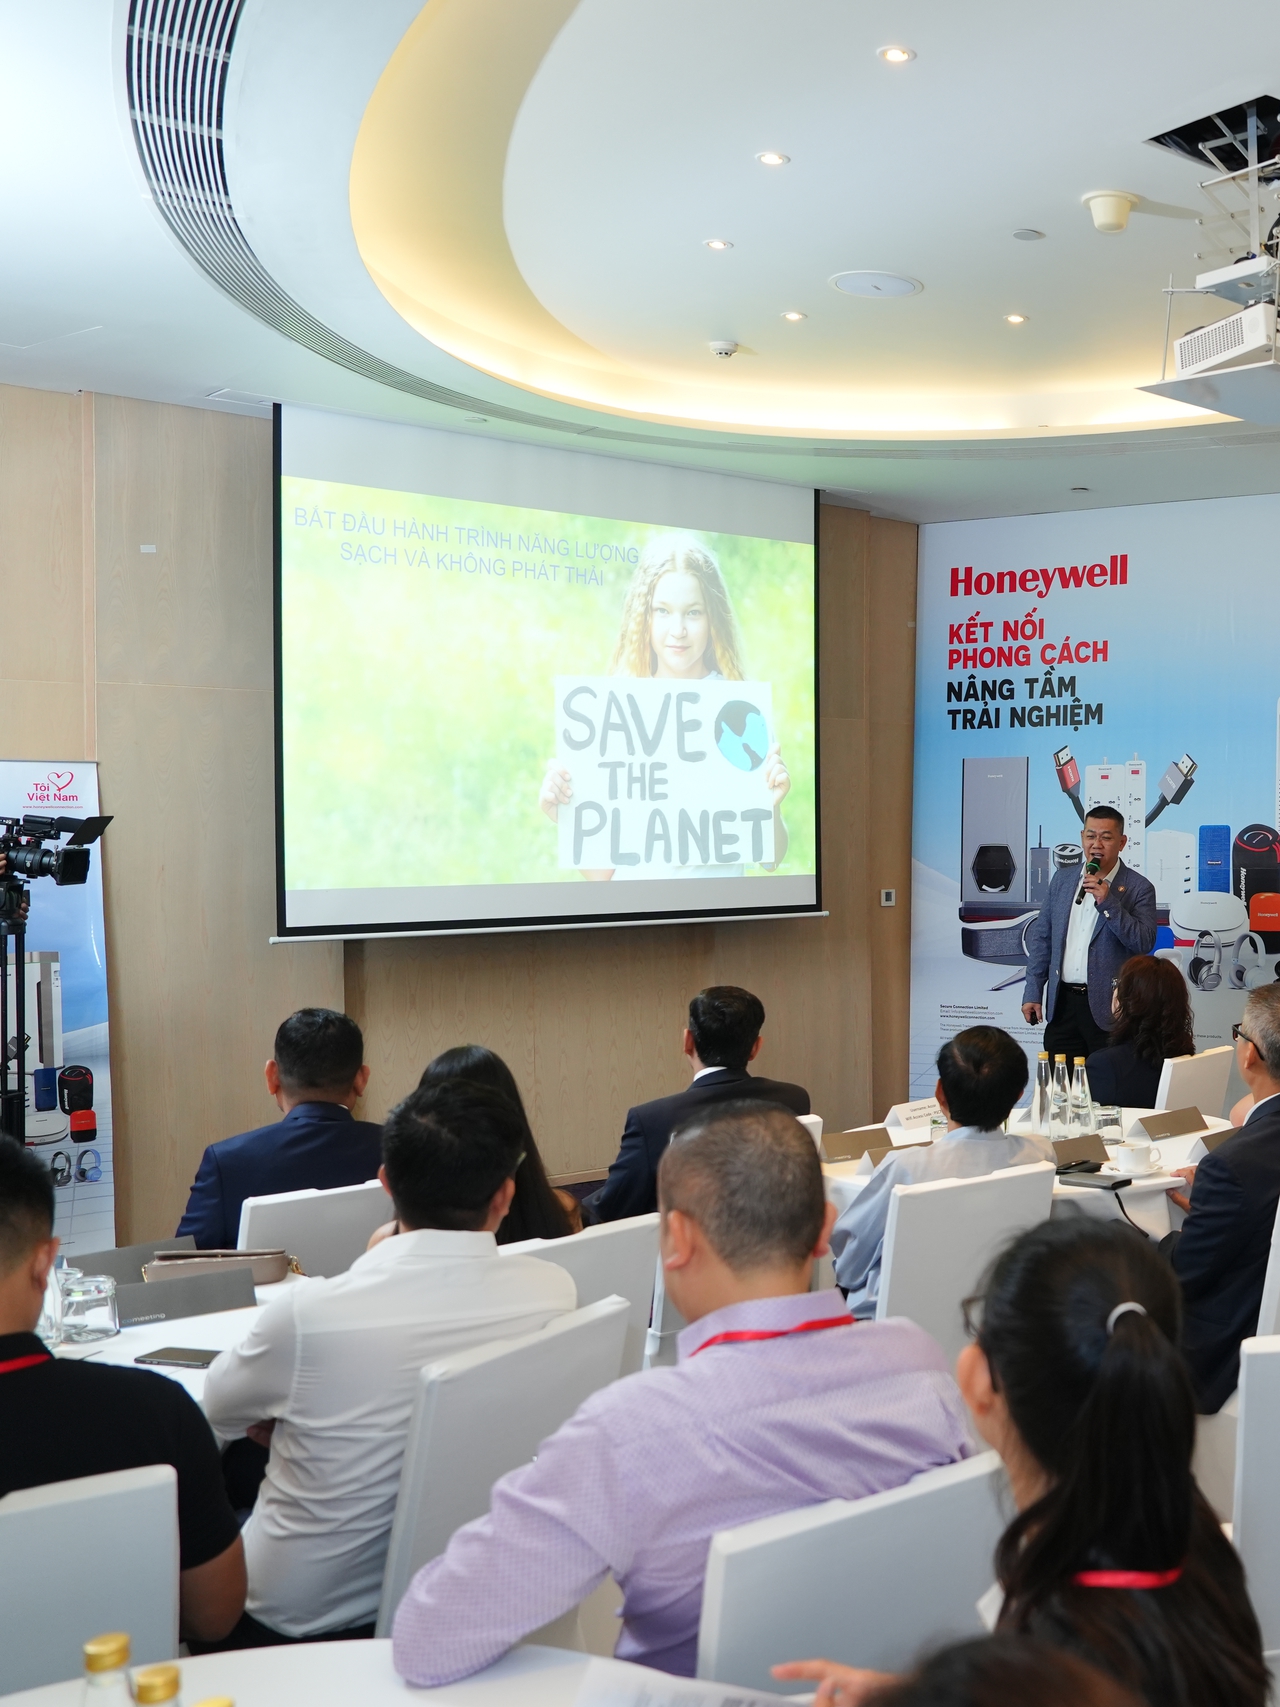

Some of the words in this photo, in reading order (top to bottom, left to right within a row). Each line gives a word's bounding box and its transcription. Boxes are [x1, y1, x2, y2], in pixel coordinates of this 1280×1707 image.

[294, 505, 337, 530] BẮT
[341, 511, 386, 536] ĐẦU
[393, 517, 449, 543] HÀNH
[454, 525, 512, 550] TRÌNH
[518, 532, 570, 557] NĂNG
[575, 541, 639, 565] LƯỢNG
[340, 542, 397, 566] SẠCH
[404, 546, 431, 569] VÀ
[436, 551, 506, 576] KHÔNG
[512, 560, 560, 582] PHÁT
[564, 565, 604, 587] THẢI
[949, 554, 1128, 599] Honeywell
[948, 610, 994, 645] KẾT
[1002, 607, 1045, 642] NỐI
[948, 644, 1031, 670] PHONG
[1039, 635, 1109, 666] CÁCH
[946, 673, 1015, 703] NÂNG
[1024, 665, 1077, 700] TẦM
[562, 685, 708, 763] SAVE
[947, 701, 1000, 731] TRẢI
[1009, 696, 1104, 732] NGHIỆM
[27, 792, 50, 803] Việt
[53, 793, 78, 801] Nam
[33, 783, 50, 792] Tôi
[597, 760, 669, 802] THE
[572, 800, 773, 866] PLANET
